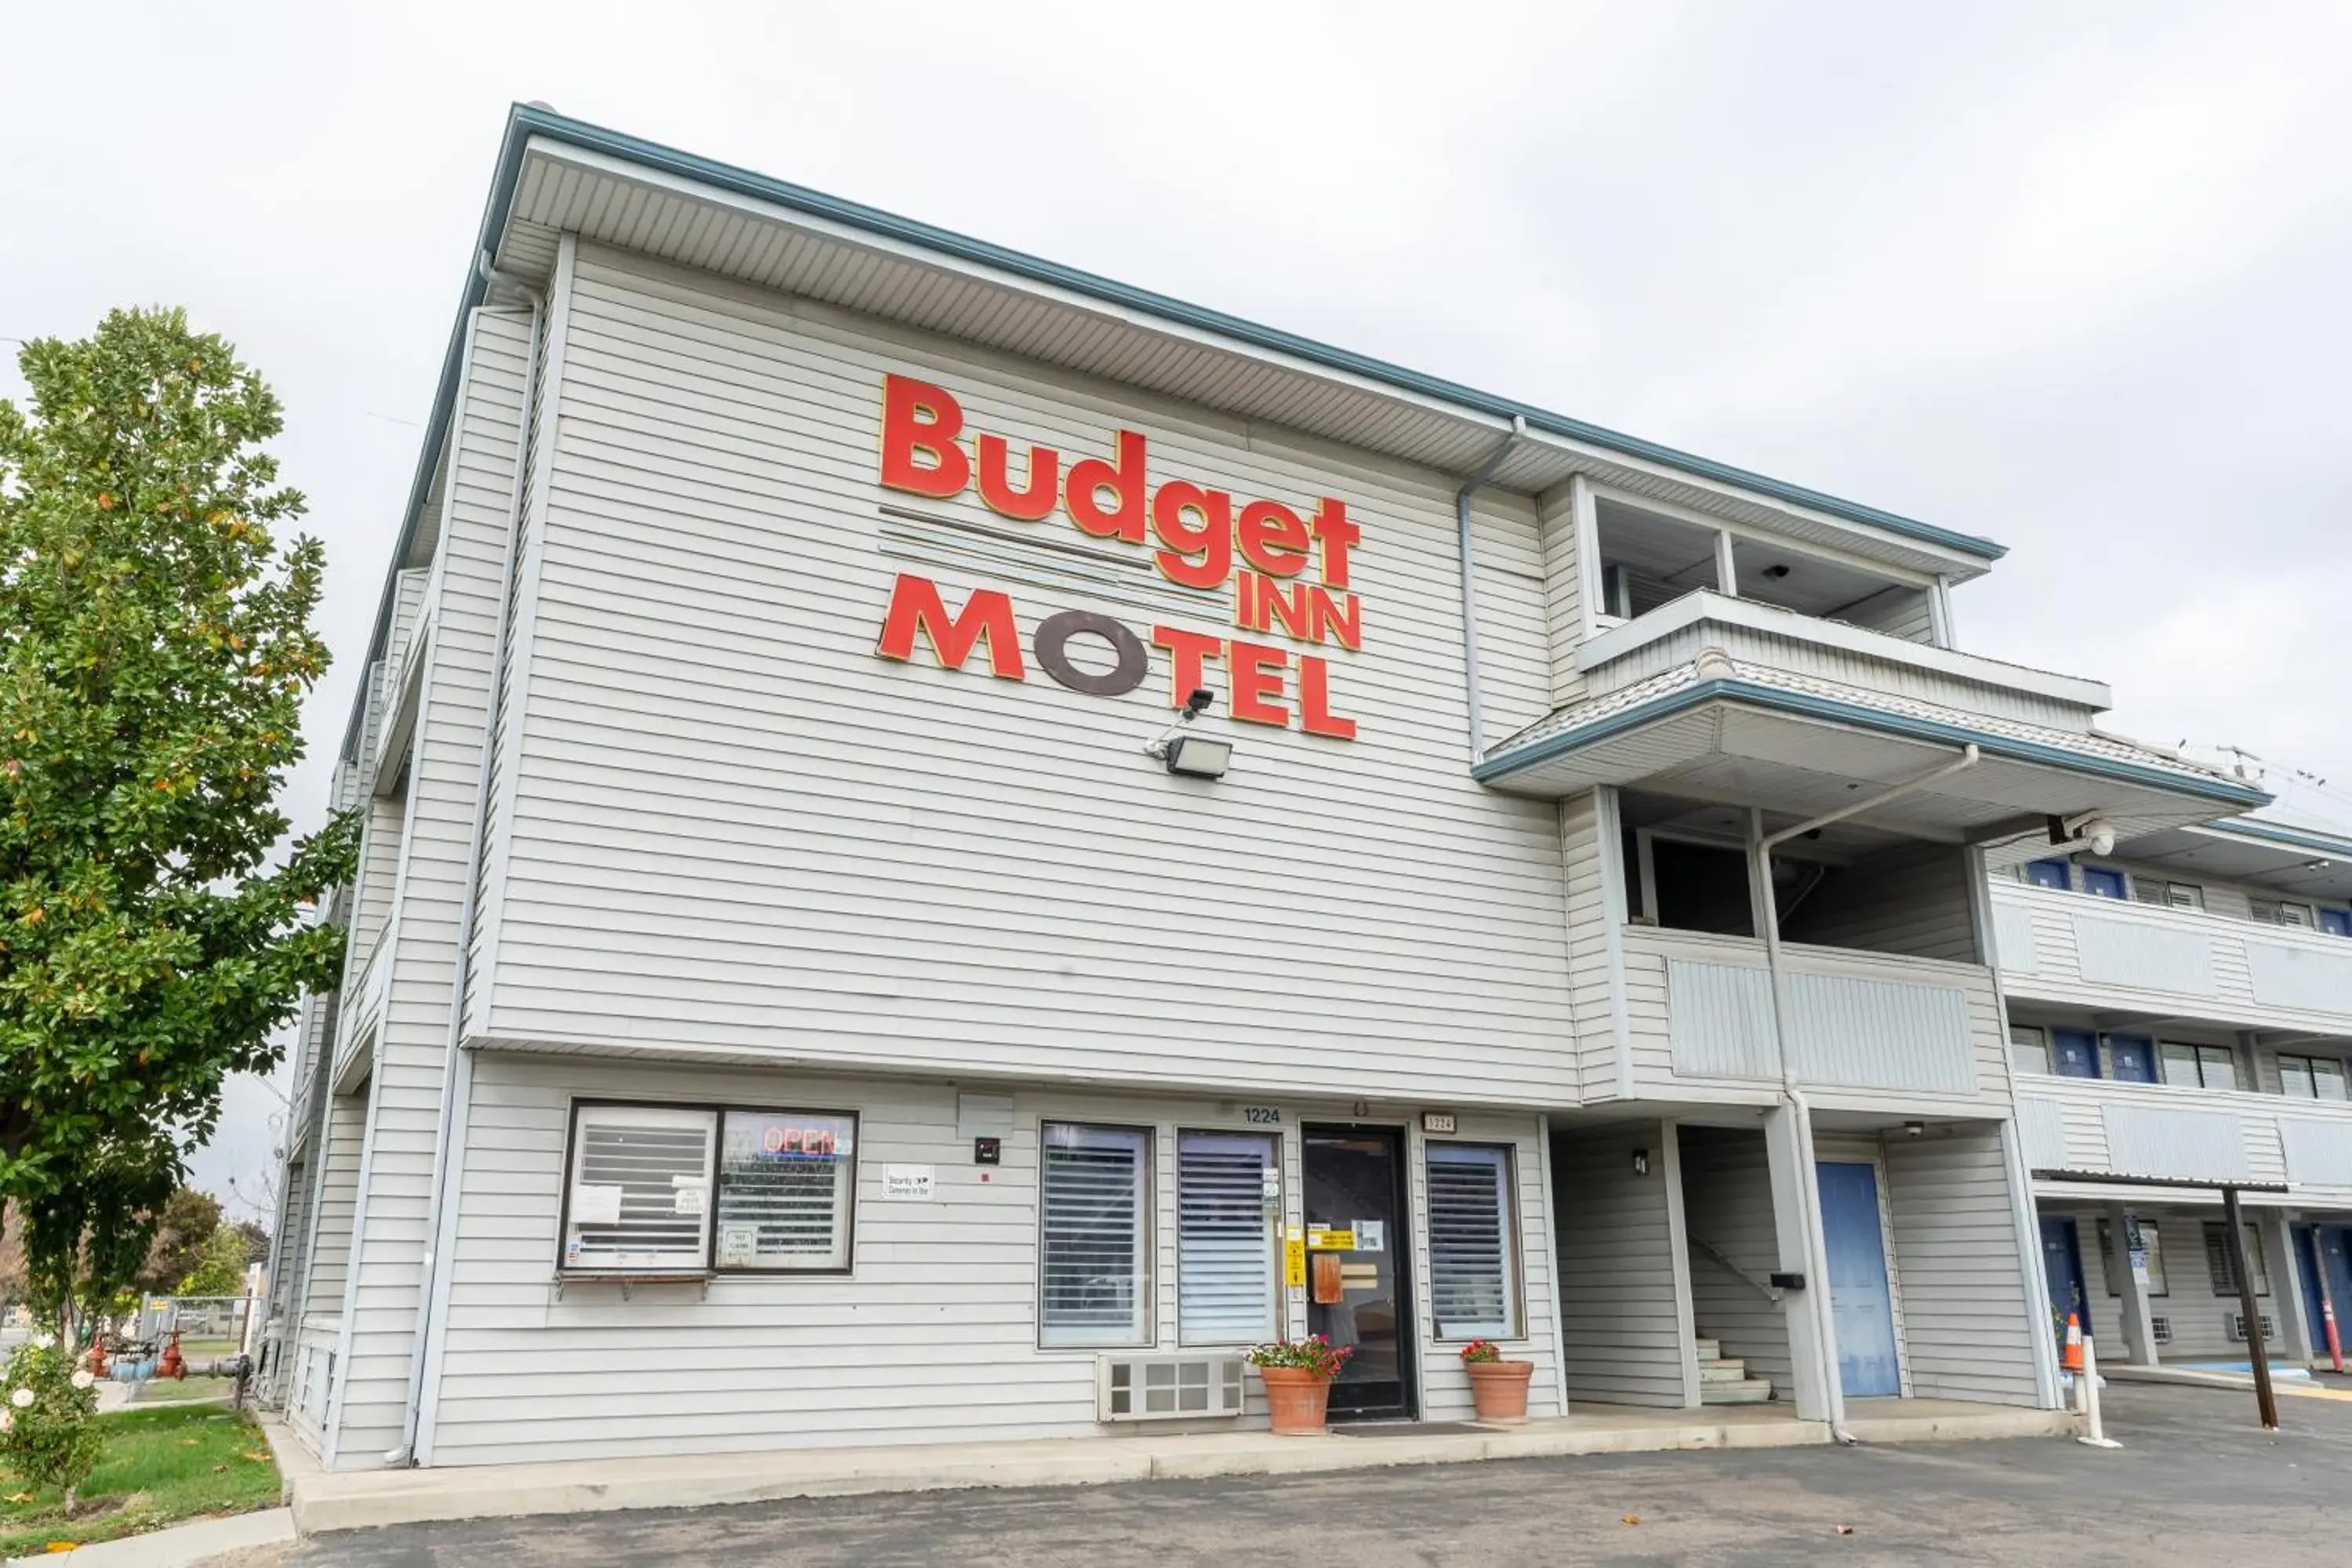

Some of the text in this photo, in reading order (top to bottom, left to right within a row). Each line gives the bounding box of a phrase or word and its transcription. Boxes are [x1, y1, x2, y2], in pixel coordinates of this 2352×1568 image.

[880, 372, 1360, 590] Budget
[1235, 570, 1361, 652] INN
[878, 571, 1357, 739] MOTEL
[764, 1126, 839, 1155] OPEN
[1244, 1107, 1279, 1123] 1224
